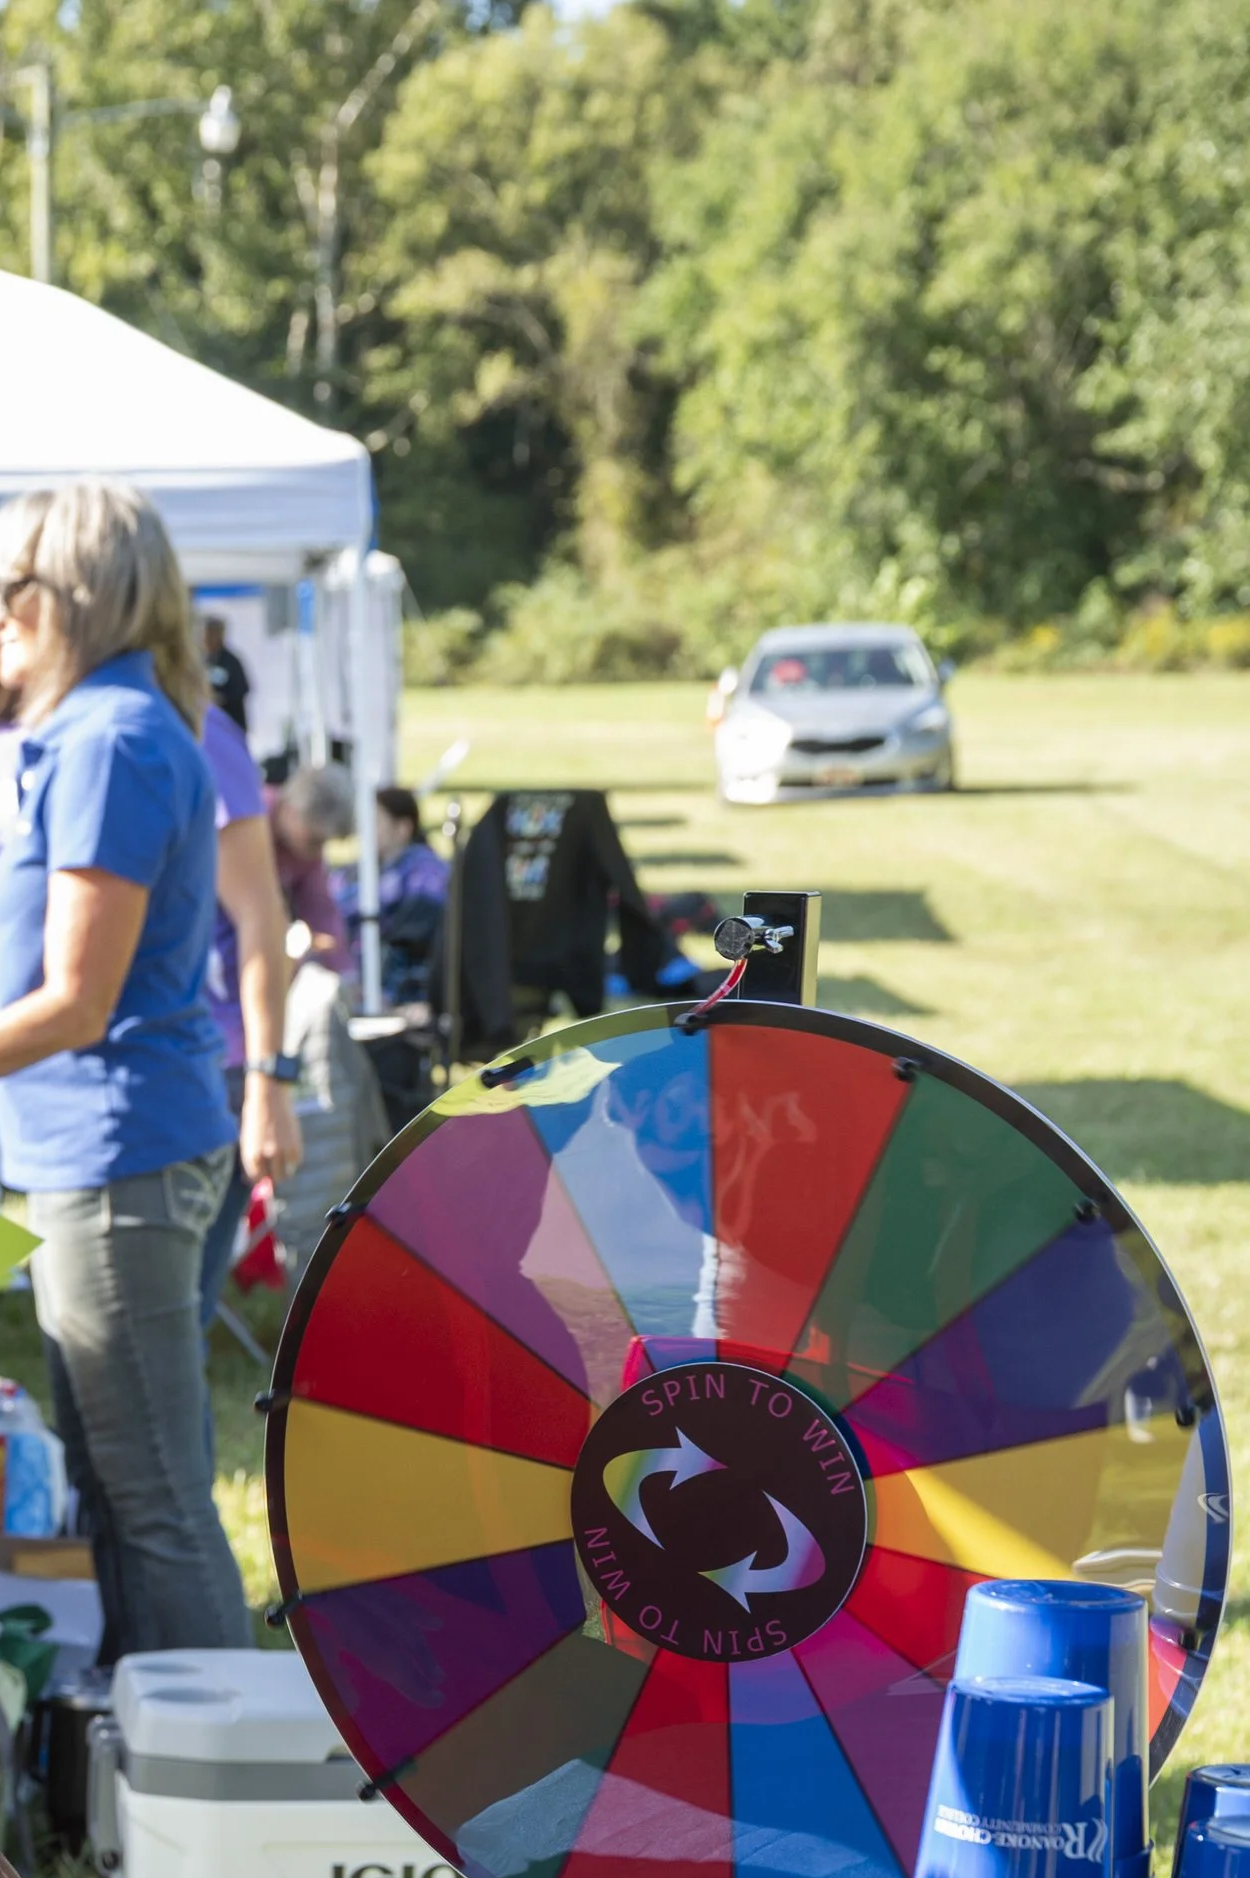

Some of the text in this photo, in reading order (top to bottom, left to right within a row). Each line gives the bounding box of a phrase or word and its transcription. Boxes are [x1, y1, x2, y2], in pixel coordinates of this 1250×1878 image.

[641, 1373, 855, 1495] SPIN TO WIN
[584, 1527, 787, 1655] SPIN TO WIN
